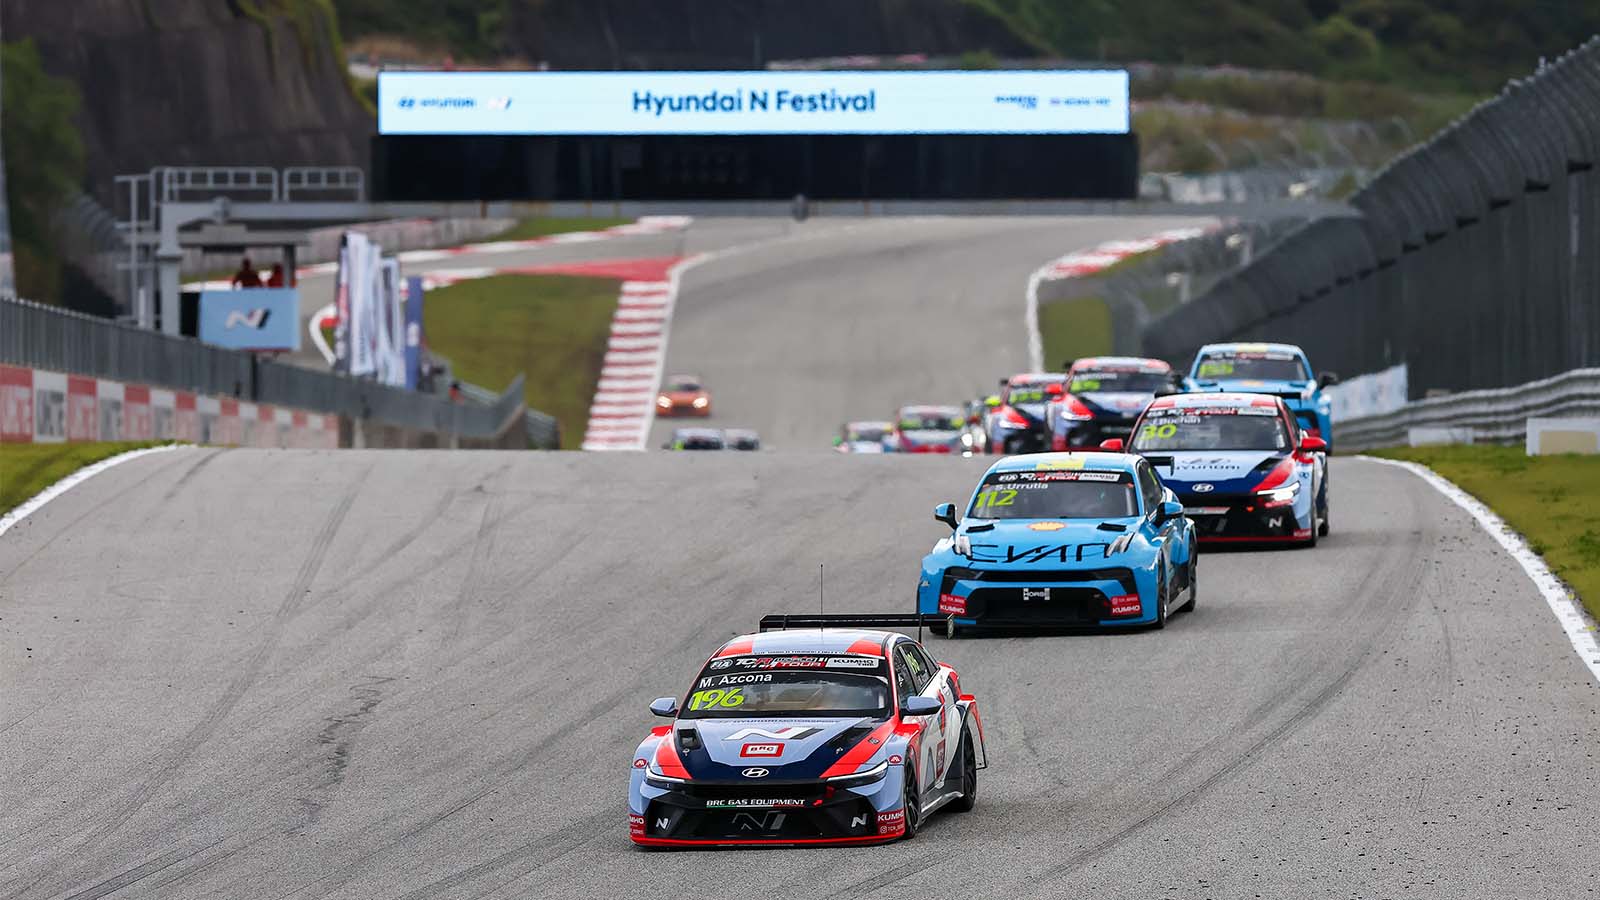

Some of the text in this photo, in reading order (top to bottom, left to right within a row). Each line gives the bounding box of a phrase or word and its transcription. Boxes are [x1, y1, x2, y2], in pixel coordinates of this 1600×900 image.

[632, 89, 876, 117] Hyundai N Festival
[1138, 424, 1178, 440] 30
[974, 490, 1019, 509] 112
[940, 604, 965, 614] KUMHO
[1112, 604, 1141, 614] KUMHO
[698, 673, 773, 689] M. Azcona
[688, 688, 746, 711] 196
[750, 798, 806, 806] EQUIPMENT
